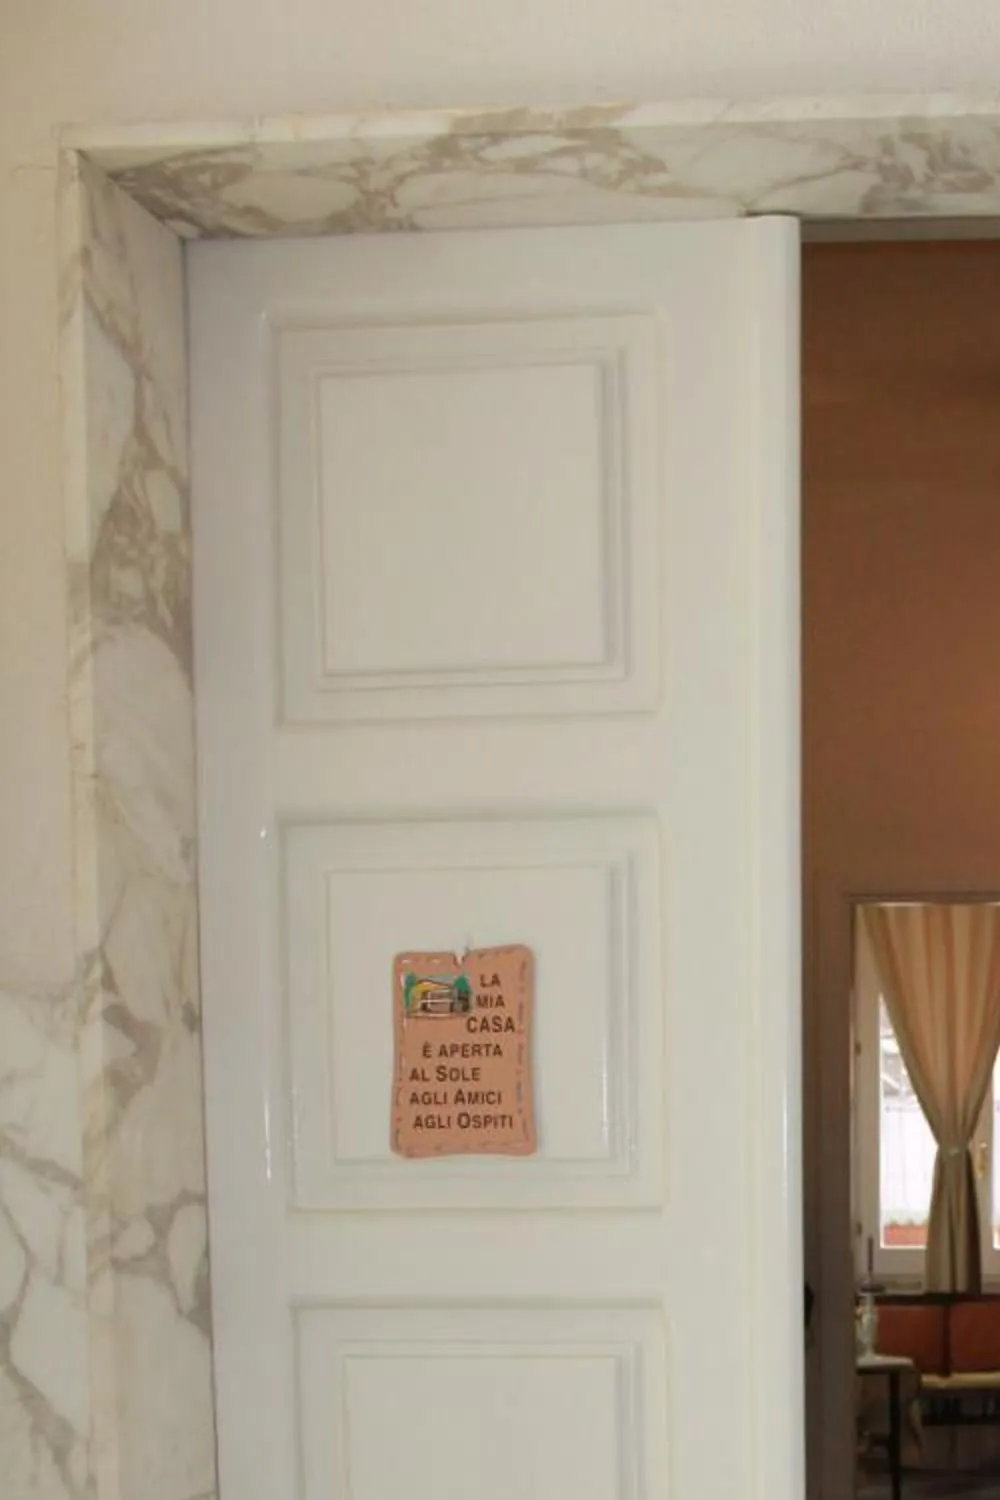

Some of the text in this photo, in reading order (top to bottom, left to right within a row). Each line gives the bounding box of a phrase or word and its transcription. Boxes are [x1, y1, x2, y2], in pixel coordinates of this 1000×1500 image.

[480, 973, 501, 988] LA
[476, 995, 505, 1008] MIA
[466, 1016, 516, 1034] CASA
[438, 1043, 503, 1058] APERTA
[409, 1065, 481, 1082] AL SOLE
[409, 1088, 503, 1106] AGLI AMICI
[412, 1112, 514, 1130] AGLI OSPITI
